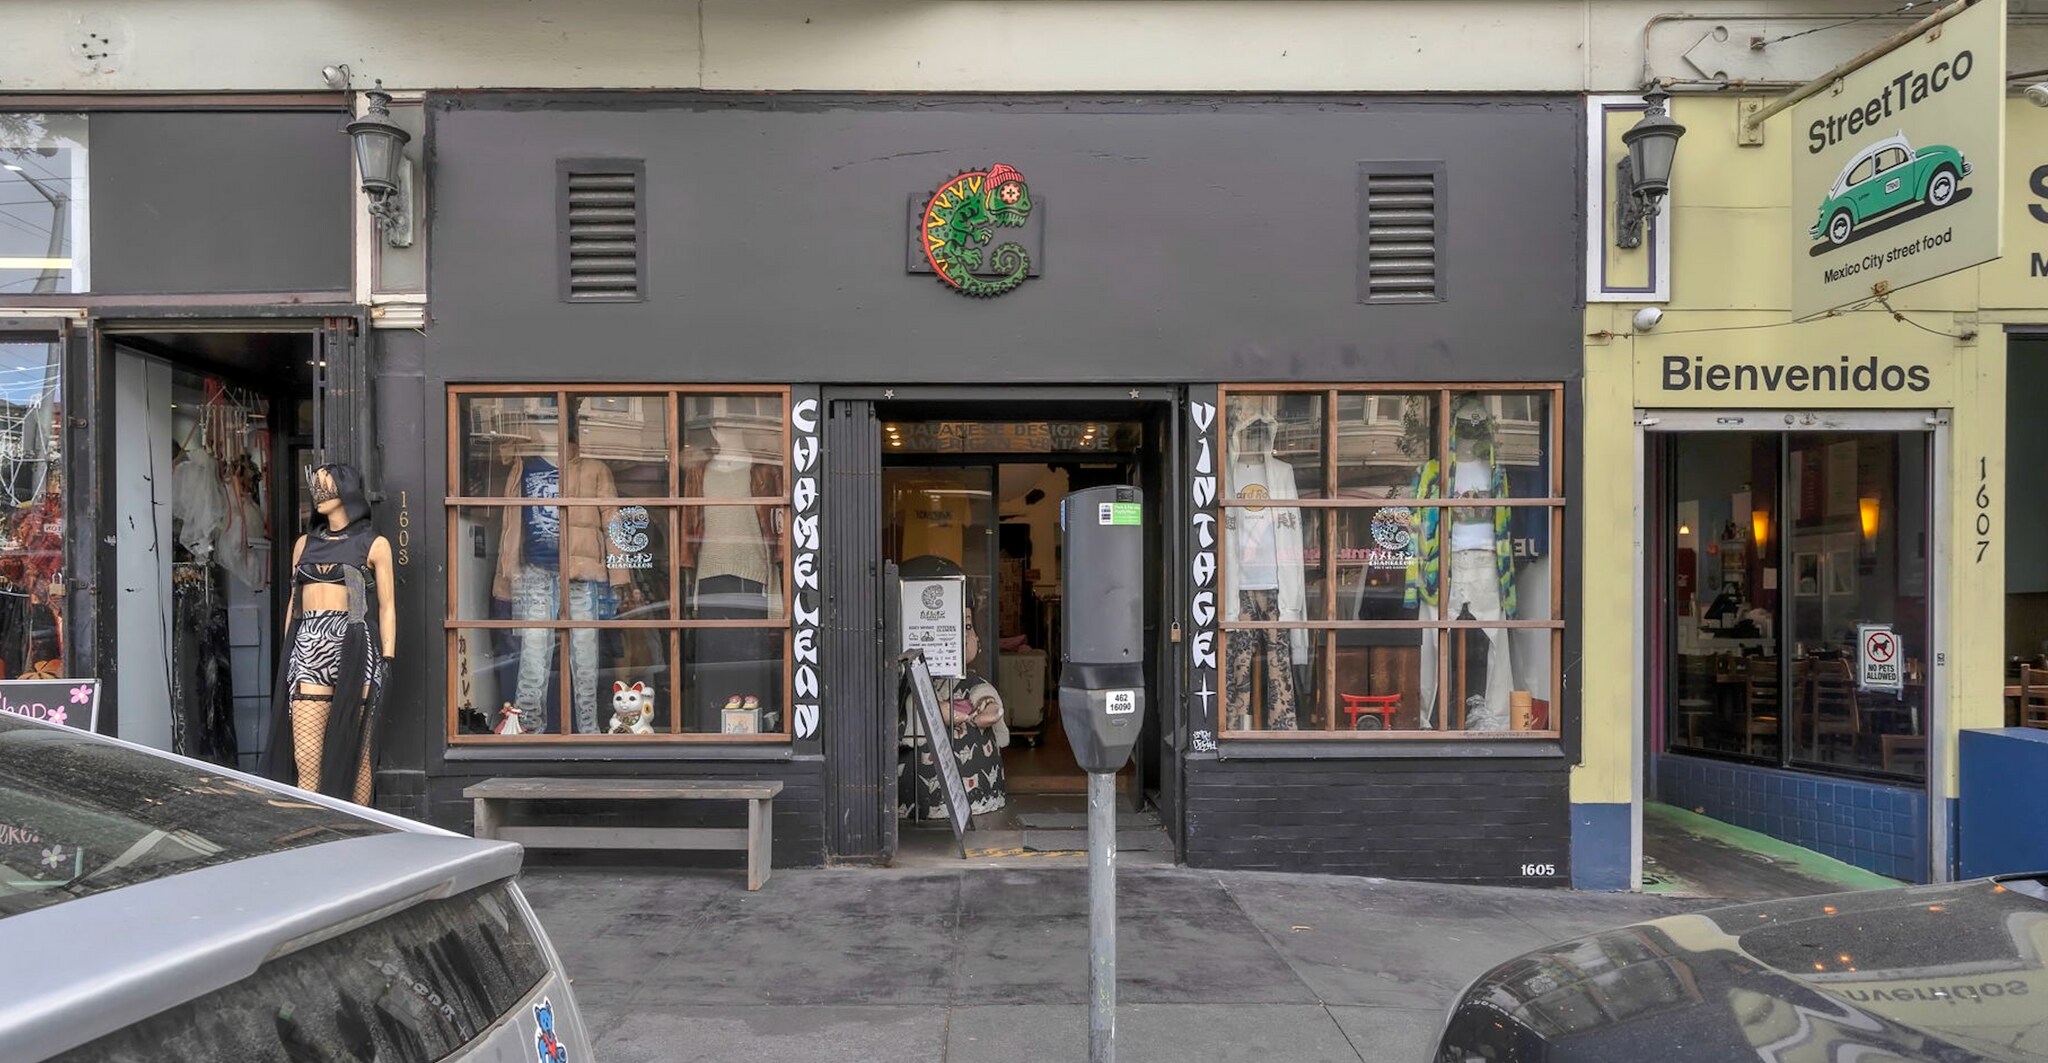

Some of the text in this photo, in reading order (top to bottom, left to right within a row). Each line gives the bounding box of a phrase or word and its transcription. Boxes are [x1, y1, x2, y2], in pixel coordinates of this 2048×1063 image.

[1823, 227, 1953, 285] Mexico City street food
[1662, 355, 1931, 392] Bienvenidos
[907, 423, 1110, 437] JAPANESE DESIGNR
[905, 437, 1011, 450] AMERICAN
[1236, 489, 1254, 500] ard
[1974, 455, 1990, 564] 1607
[398, 490, 409, 566] 1603
[1190, 401, 1218, 670] VINTAGE
[606, 553, 653, 563] カメレオン
[1867, 664, 1895, 673] NO PETS
[1866, 672, 1897, 681] ALLOWED
[1114, 693, 1129, 702] 462
[1110, 702, 1132, 711] 16090
[1521, 863, 1555, 876] 1605
